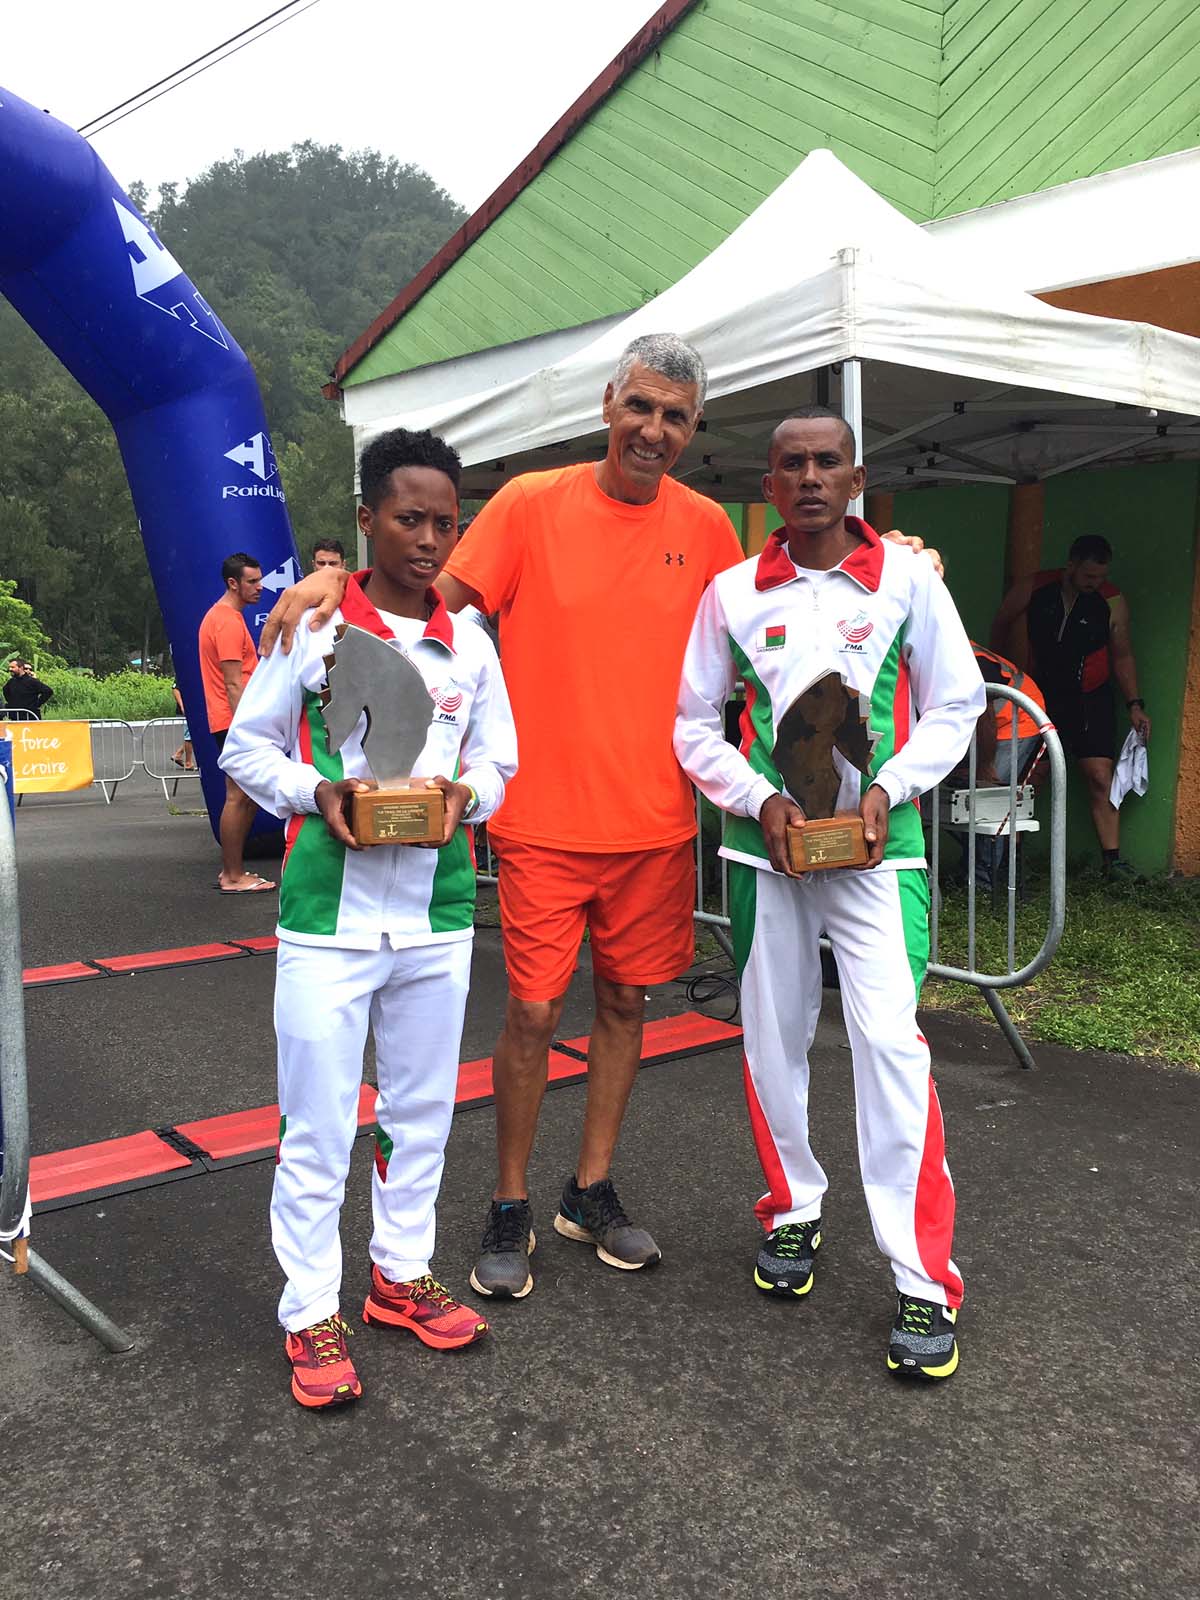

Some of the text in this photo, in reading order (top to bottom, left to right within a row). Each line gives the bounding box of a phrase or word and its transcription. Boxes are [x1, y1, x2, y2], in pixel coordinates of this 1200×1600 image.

[844, 643, 863, 651] FMA
[438, 713, 456, 722] FMA
[19, 727, 61, 752] force
[22, 760, 69, 775] croire
